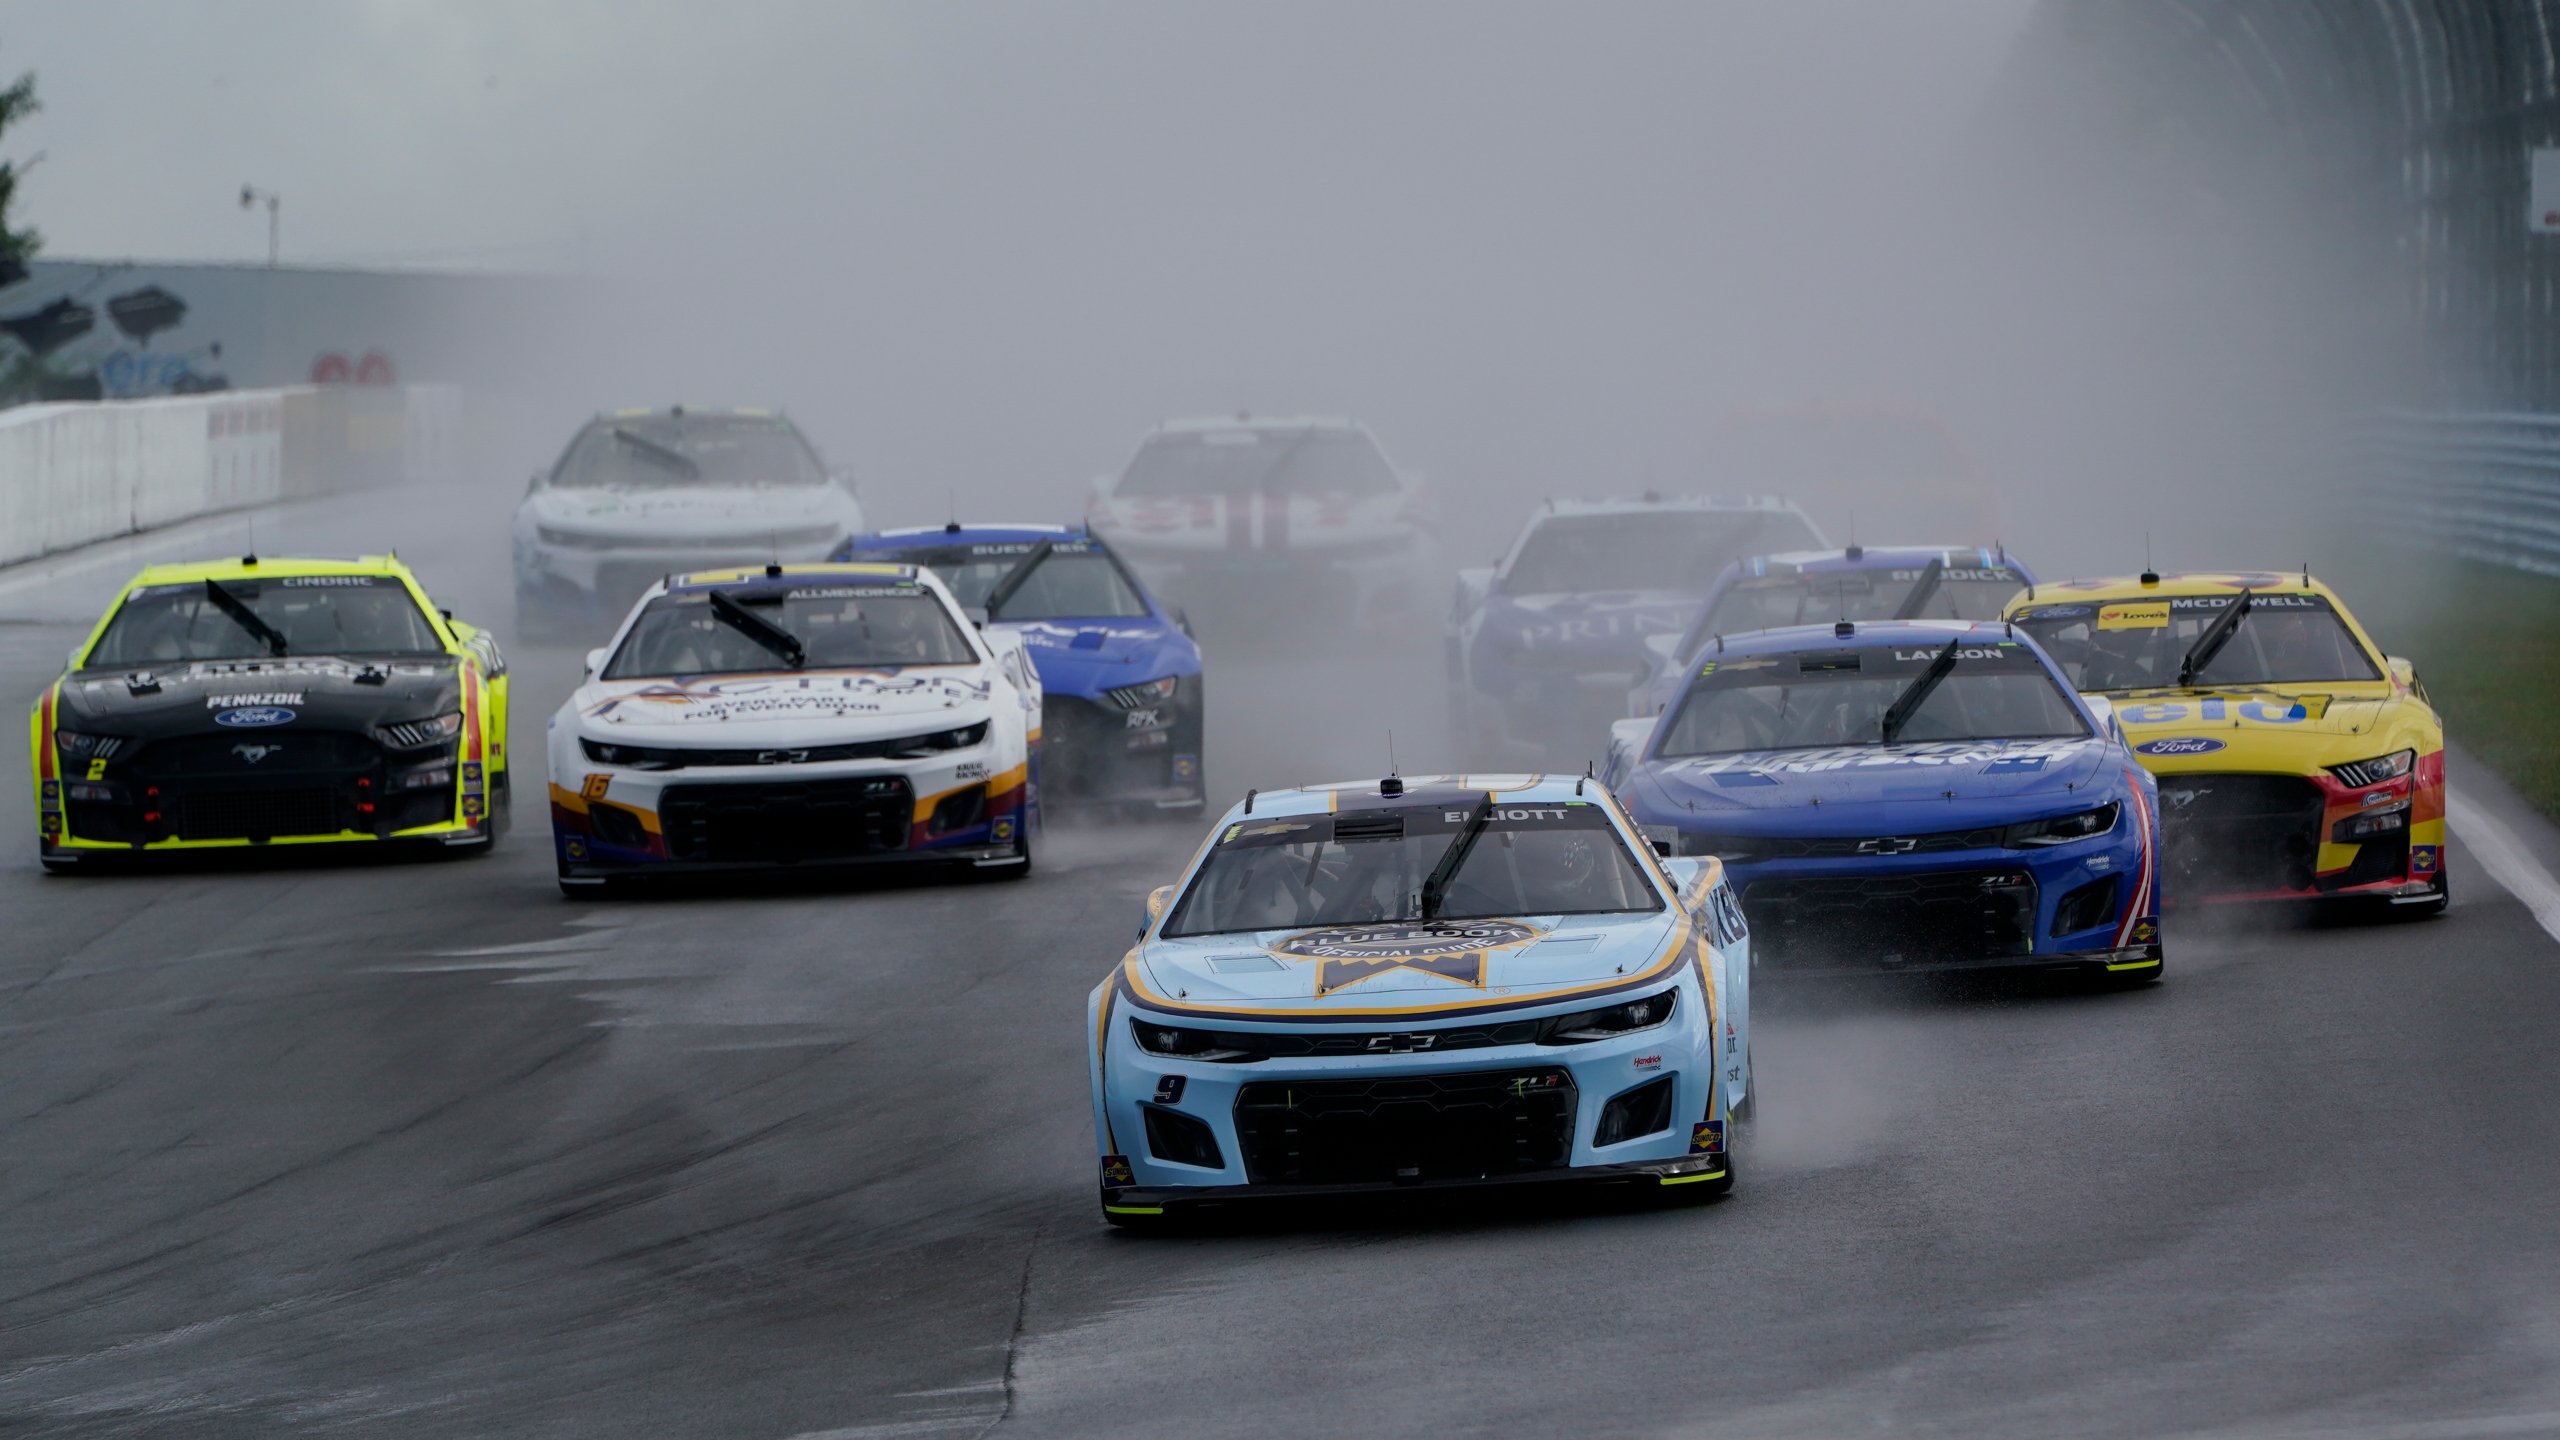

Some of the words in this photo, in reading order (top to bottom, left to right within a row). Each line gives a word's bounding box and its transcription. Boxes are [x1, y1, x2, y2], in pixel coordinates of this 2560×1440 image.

[282, 576, 373, 588] CINDRIC
[2122, 611, 2167, 619] Love's
[206, 693, 306, 709] PENNZOIL
[710, 698, 780, 709] EVERY
[684, 709, 727, 719] FOR
[735, 703, 807, 712] EVERY
[815, 702, 881, 711] DOOR
[1126, 710, 1158, 728] RFK
[86, 758, 107, 780] 2
[580, 773, 615, 800] 16
[2086, 856, 2110, 867] Hendrick
[1979, 875, 2023, 886] ZL1
[2133, 927, 2156, 937] SUNOCO
[1290, 932, 1398, 951] BLUE
[1407, 928, 1522, 940] BOOK
[1633, 1055, 1662, 1067] Hendrick
[1152, 1073, 1188, 1106] 9
[1692, 1132, 1722, 1144] SUNOCO
[1106, 1166, 1131, 1177] SUNOCO
